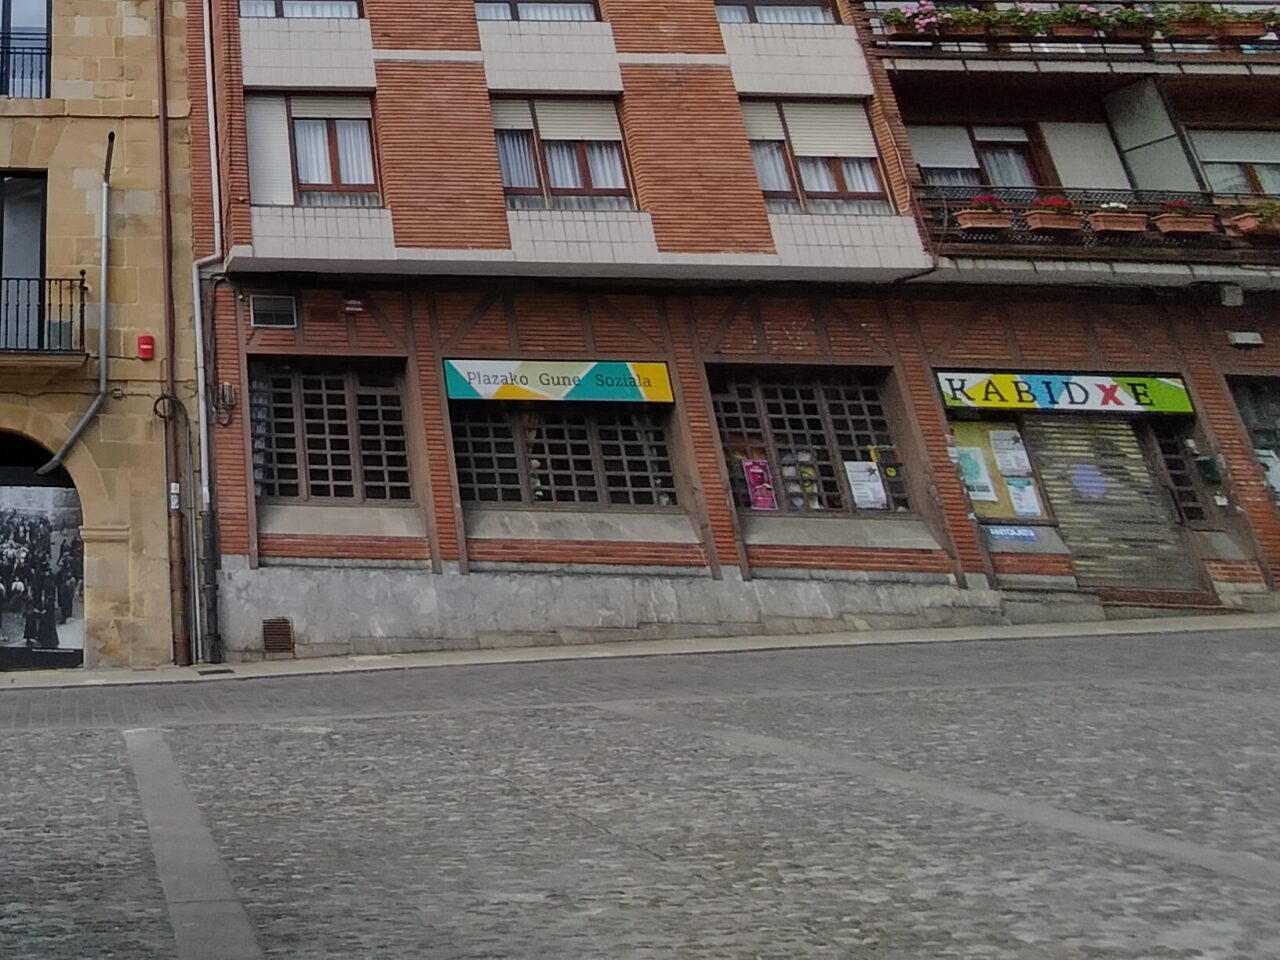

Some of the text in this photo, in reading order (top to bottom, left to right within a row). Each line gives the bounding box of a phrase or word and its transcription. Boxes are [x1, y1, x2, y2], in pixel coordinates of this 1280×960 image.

[466, 371, 652, 388] Plazako Gune Soziala
[945, 377, 1154, 407] KABIDXE
